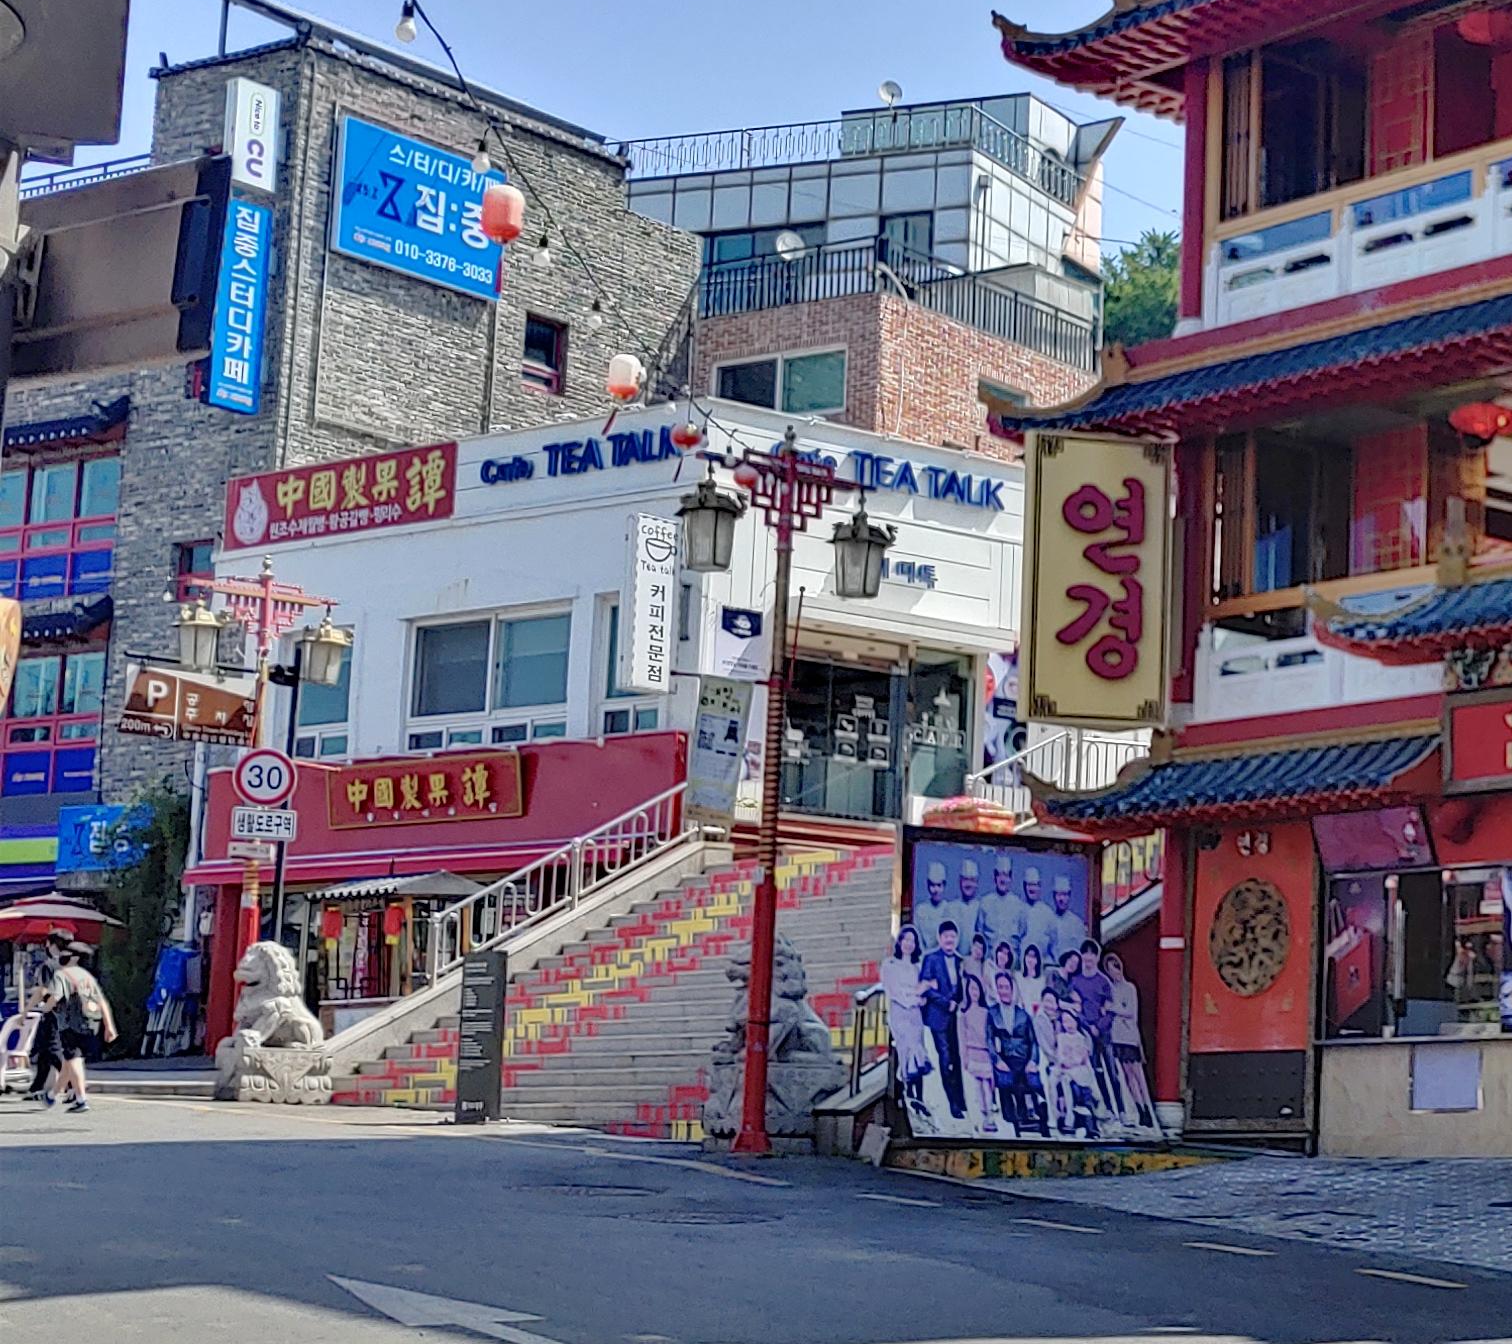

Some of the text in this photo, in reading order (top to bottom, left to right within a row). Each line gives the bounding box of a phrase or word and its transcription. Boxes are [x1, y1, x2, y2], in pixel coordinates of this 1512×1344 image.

[245, 138, 265, 179] CU
[394, 239, 493, 285] 010-3376-3033
[223, 206, 261, 385] 집중스터디카페
[543, 440, 604, 477] TEA
[847, 449, 919, 495] TEA
[921, 465, 1005, 511] TALK
[1055, 477, 1146, 682] 연경
[648, 584, 666, 683] 커피전문점
[147, 679, 169, 708] P
[120, 718, 151, 733] 200m
[247, 764, 283, 790] 30
